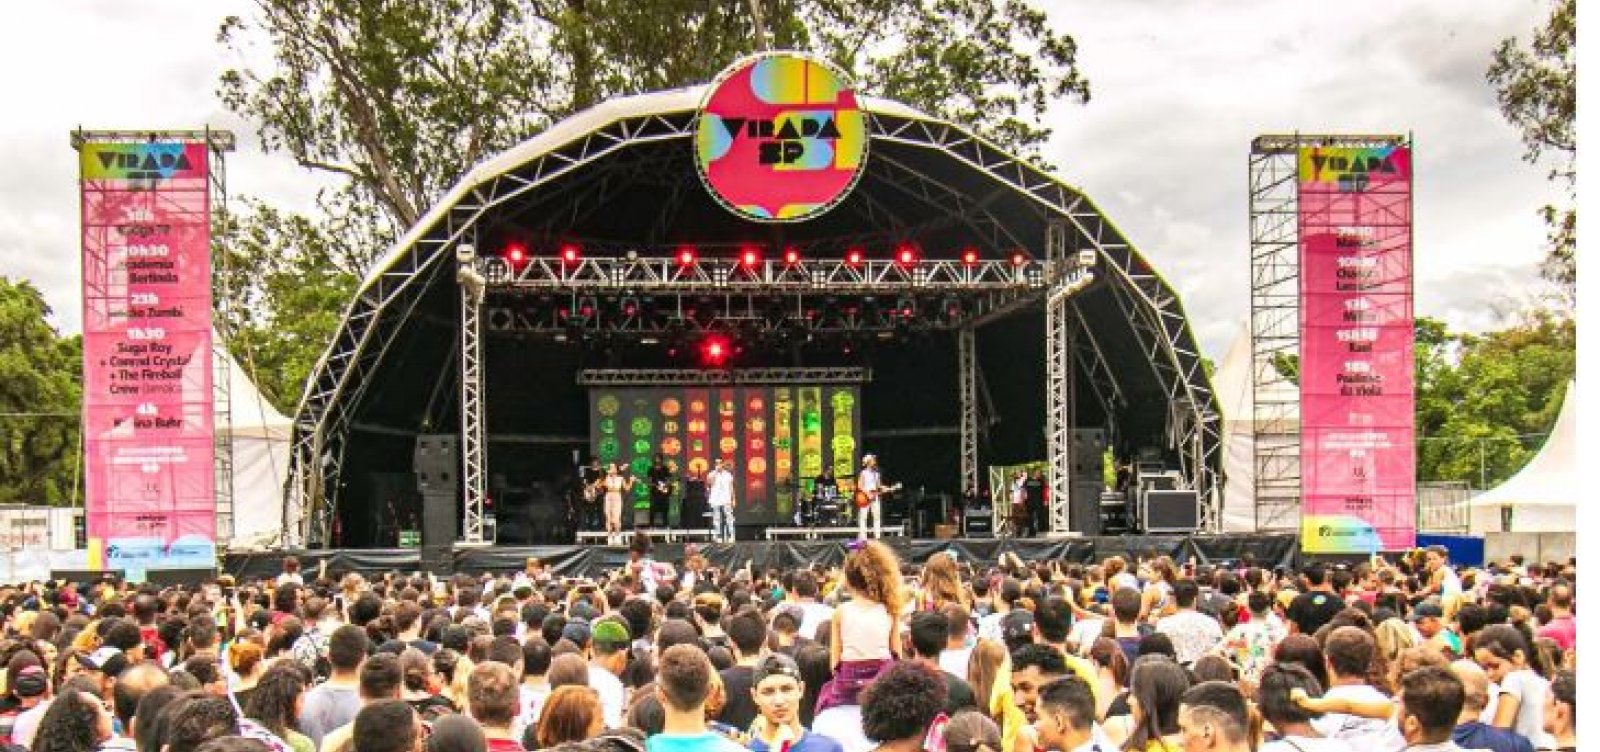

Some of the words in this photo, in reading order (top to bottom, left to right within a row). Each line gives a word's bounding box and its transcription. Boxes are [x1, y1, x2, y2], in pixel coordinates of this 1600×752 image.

[721, 117, 842, 139] VIRADA
[96, 151, 193, 171] VIRADA
[758, 141, 804, 166] SP
[1311, 155, 1397, 173] VIRADA
[146, 303, 184, 318] Zumbi
[150, 342, 173, 355] Roy
[109, 353, 151, 367] Conrad
[153, 353, 192, 368] Crystal
[119, 369, 139, 381] The
[109, 384, 139, 395] Crew
